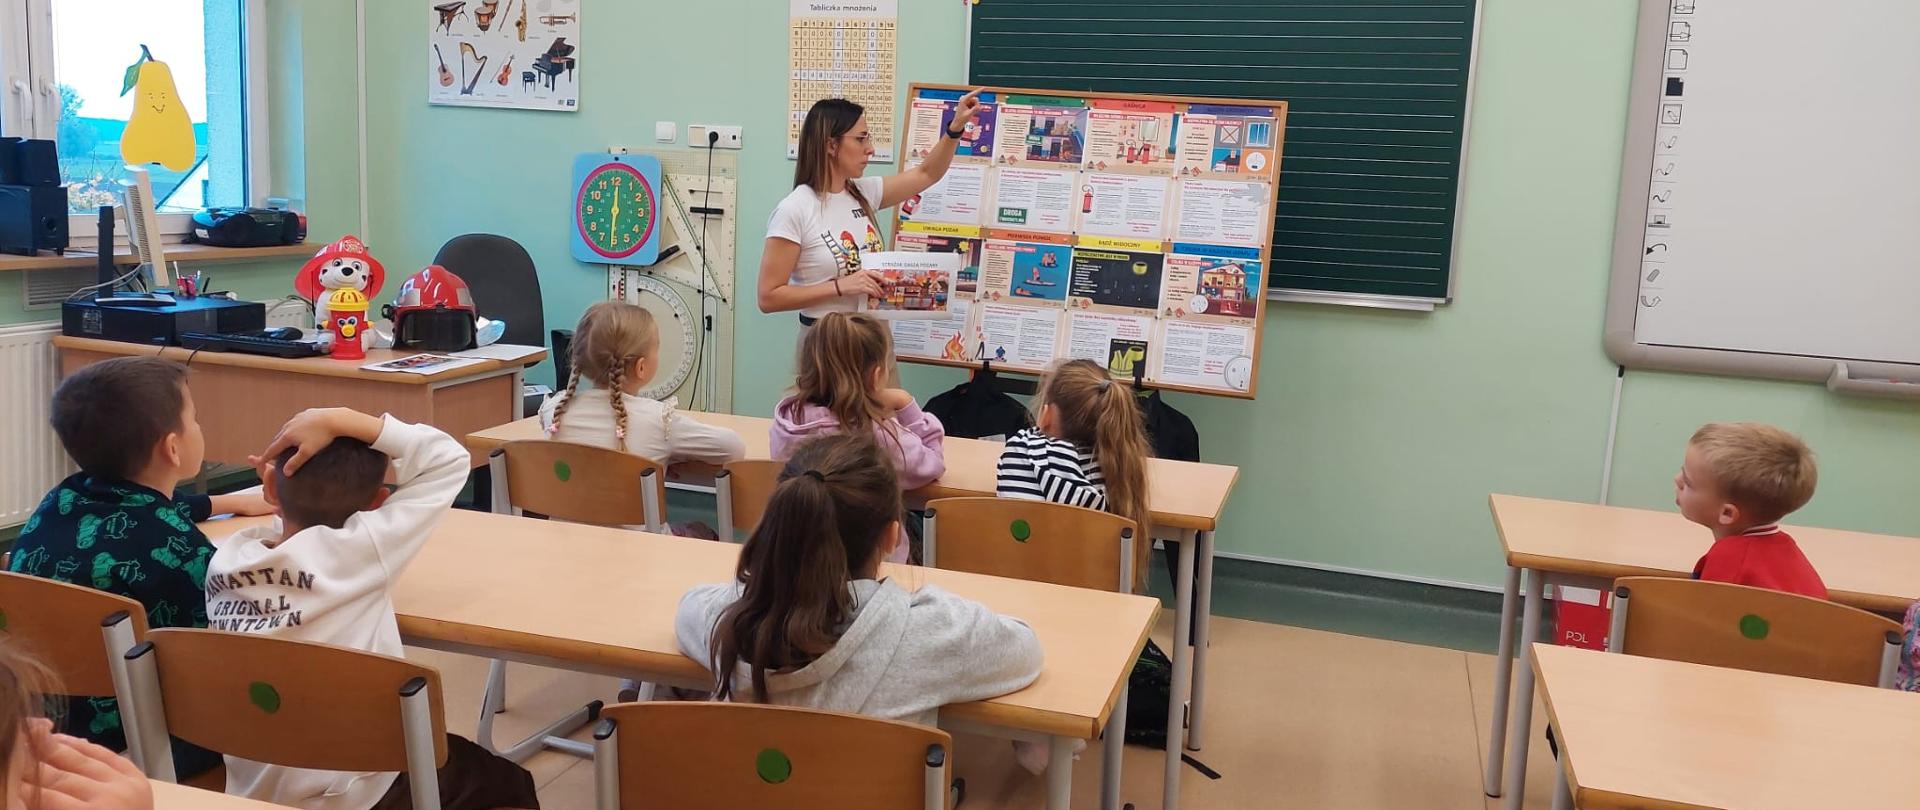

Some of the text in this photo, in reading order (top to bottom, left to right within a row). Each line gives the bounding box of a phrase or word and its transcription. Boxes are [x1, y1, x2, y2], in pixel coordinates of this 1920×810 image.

[599, 181, 607, 189] 11
[611, 177, 621, 186] 12
[629, 182, 633, 191] 1
[591, 191, 601, 200] 10
[635, 193, 642, 202] 2
[587, 206, 593, 214] 9
[638, 208, 644, 217] 3
[590, 222, 596, 231] 8
[633, 224, 639, 233] 4
[599, 232, 605, 241] 7
[624, 234, 630, 242] 5
[1566, 630, 1588, 644] POL
